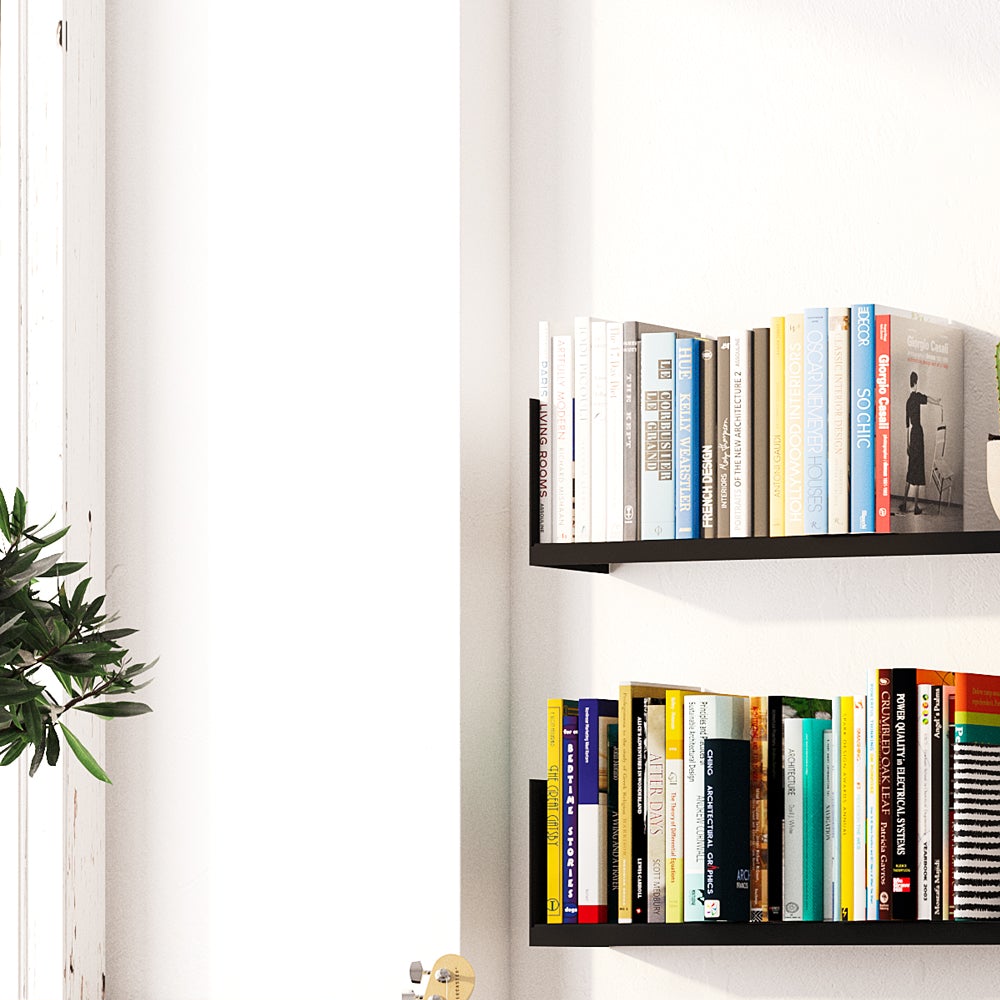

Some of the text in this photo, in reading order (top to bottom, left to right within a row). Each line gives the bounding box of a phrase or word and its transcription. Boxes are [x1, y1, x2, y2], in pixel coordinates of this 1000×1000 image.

[808, 330, 824, 382] OSCAR
[645, 392, 658, 471] LE GRAND
[658, 360, 673, 481] LE CORBUSIER
[678, 347, 692, 512] HUE KELLY WEARSTLER
[734, 378, 742, 438] ARCHITECTURE
[789, 342, 803, 522] HOLLYWOOD INTERIORS
[808, 384, 824, 454] NIEMEYER
[734, 440, 742, 458] NEW
[734, 460, 742, 475] THE
[702, 445, 713, 528] FRENCH DESIGN
[734, 476, 742, 487] OF
[808, 456, 824, 513] HOUSES
[734, 490, 742, 531] PORTRAITS
[896, 693, 906, 722] POWER
[896, 722, 906, 758] QUALITY
[548, 764, 560, 847] THE GREAT GATSBY
[668, 802, 677, 820] Theory
[880, 692, 891, 886] CRUMBLED OAK LEAF Patricia Gavros
[896, 766, 906, 817] ELECTRICAL
[649, 754, 663, 916] AFTER DAYS SCOTT MEDBURY
[706, 749, 719, 895] CHING ARCHITECTURAL GRAPHICS
[896, 818, 906, 856] SYSTEMS
[668, 858, 677, 884] Equations
